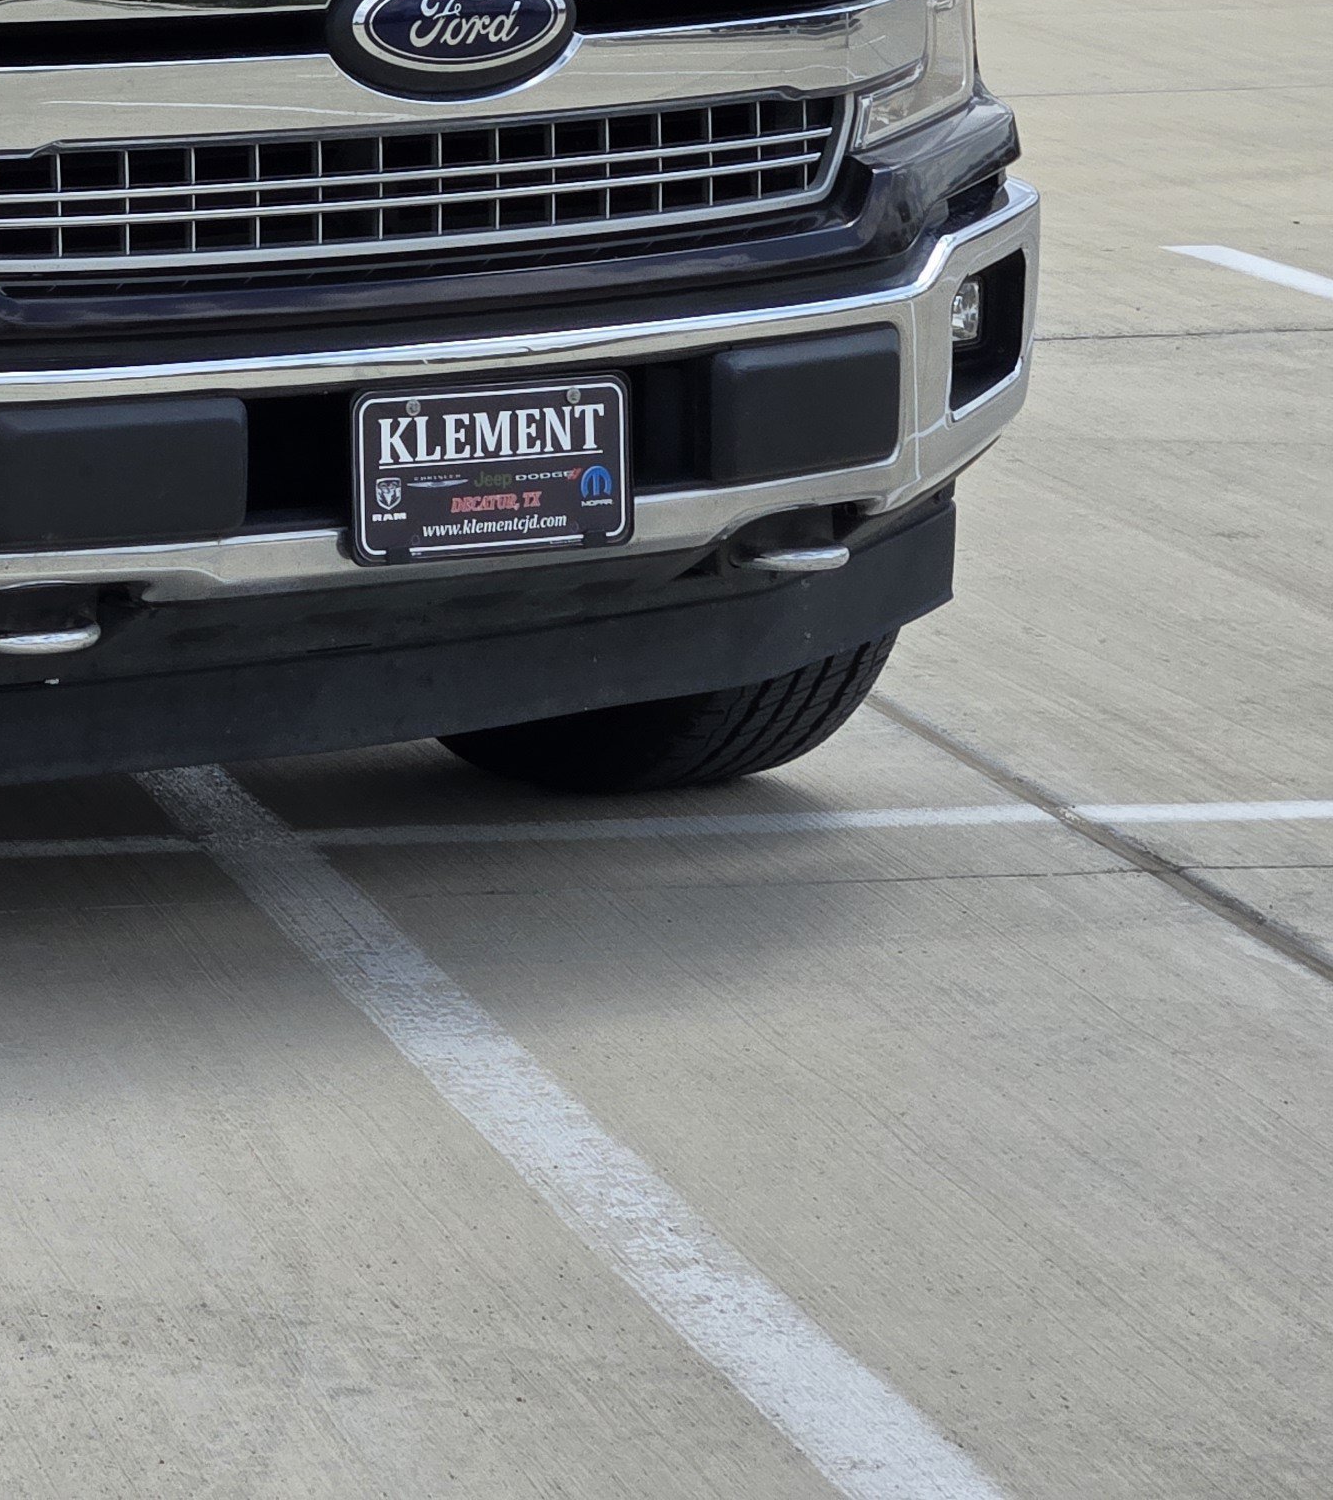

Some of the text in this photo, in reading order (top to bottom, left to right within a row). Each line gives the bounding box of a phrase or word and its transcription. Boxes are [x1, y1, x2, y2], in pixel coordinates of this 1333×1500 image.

[378, 403, 605, 464] KLEMENT
[474, 471, 513, 488] Jeep
[515, 470, 575, 481] DODGE
[522, 491, 543, 508] TX
[372, 512, 407, 522] RAM
[422, 513, 568, 537] www.klementcjd.com
